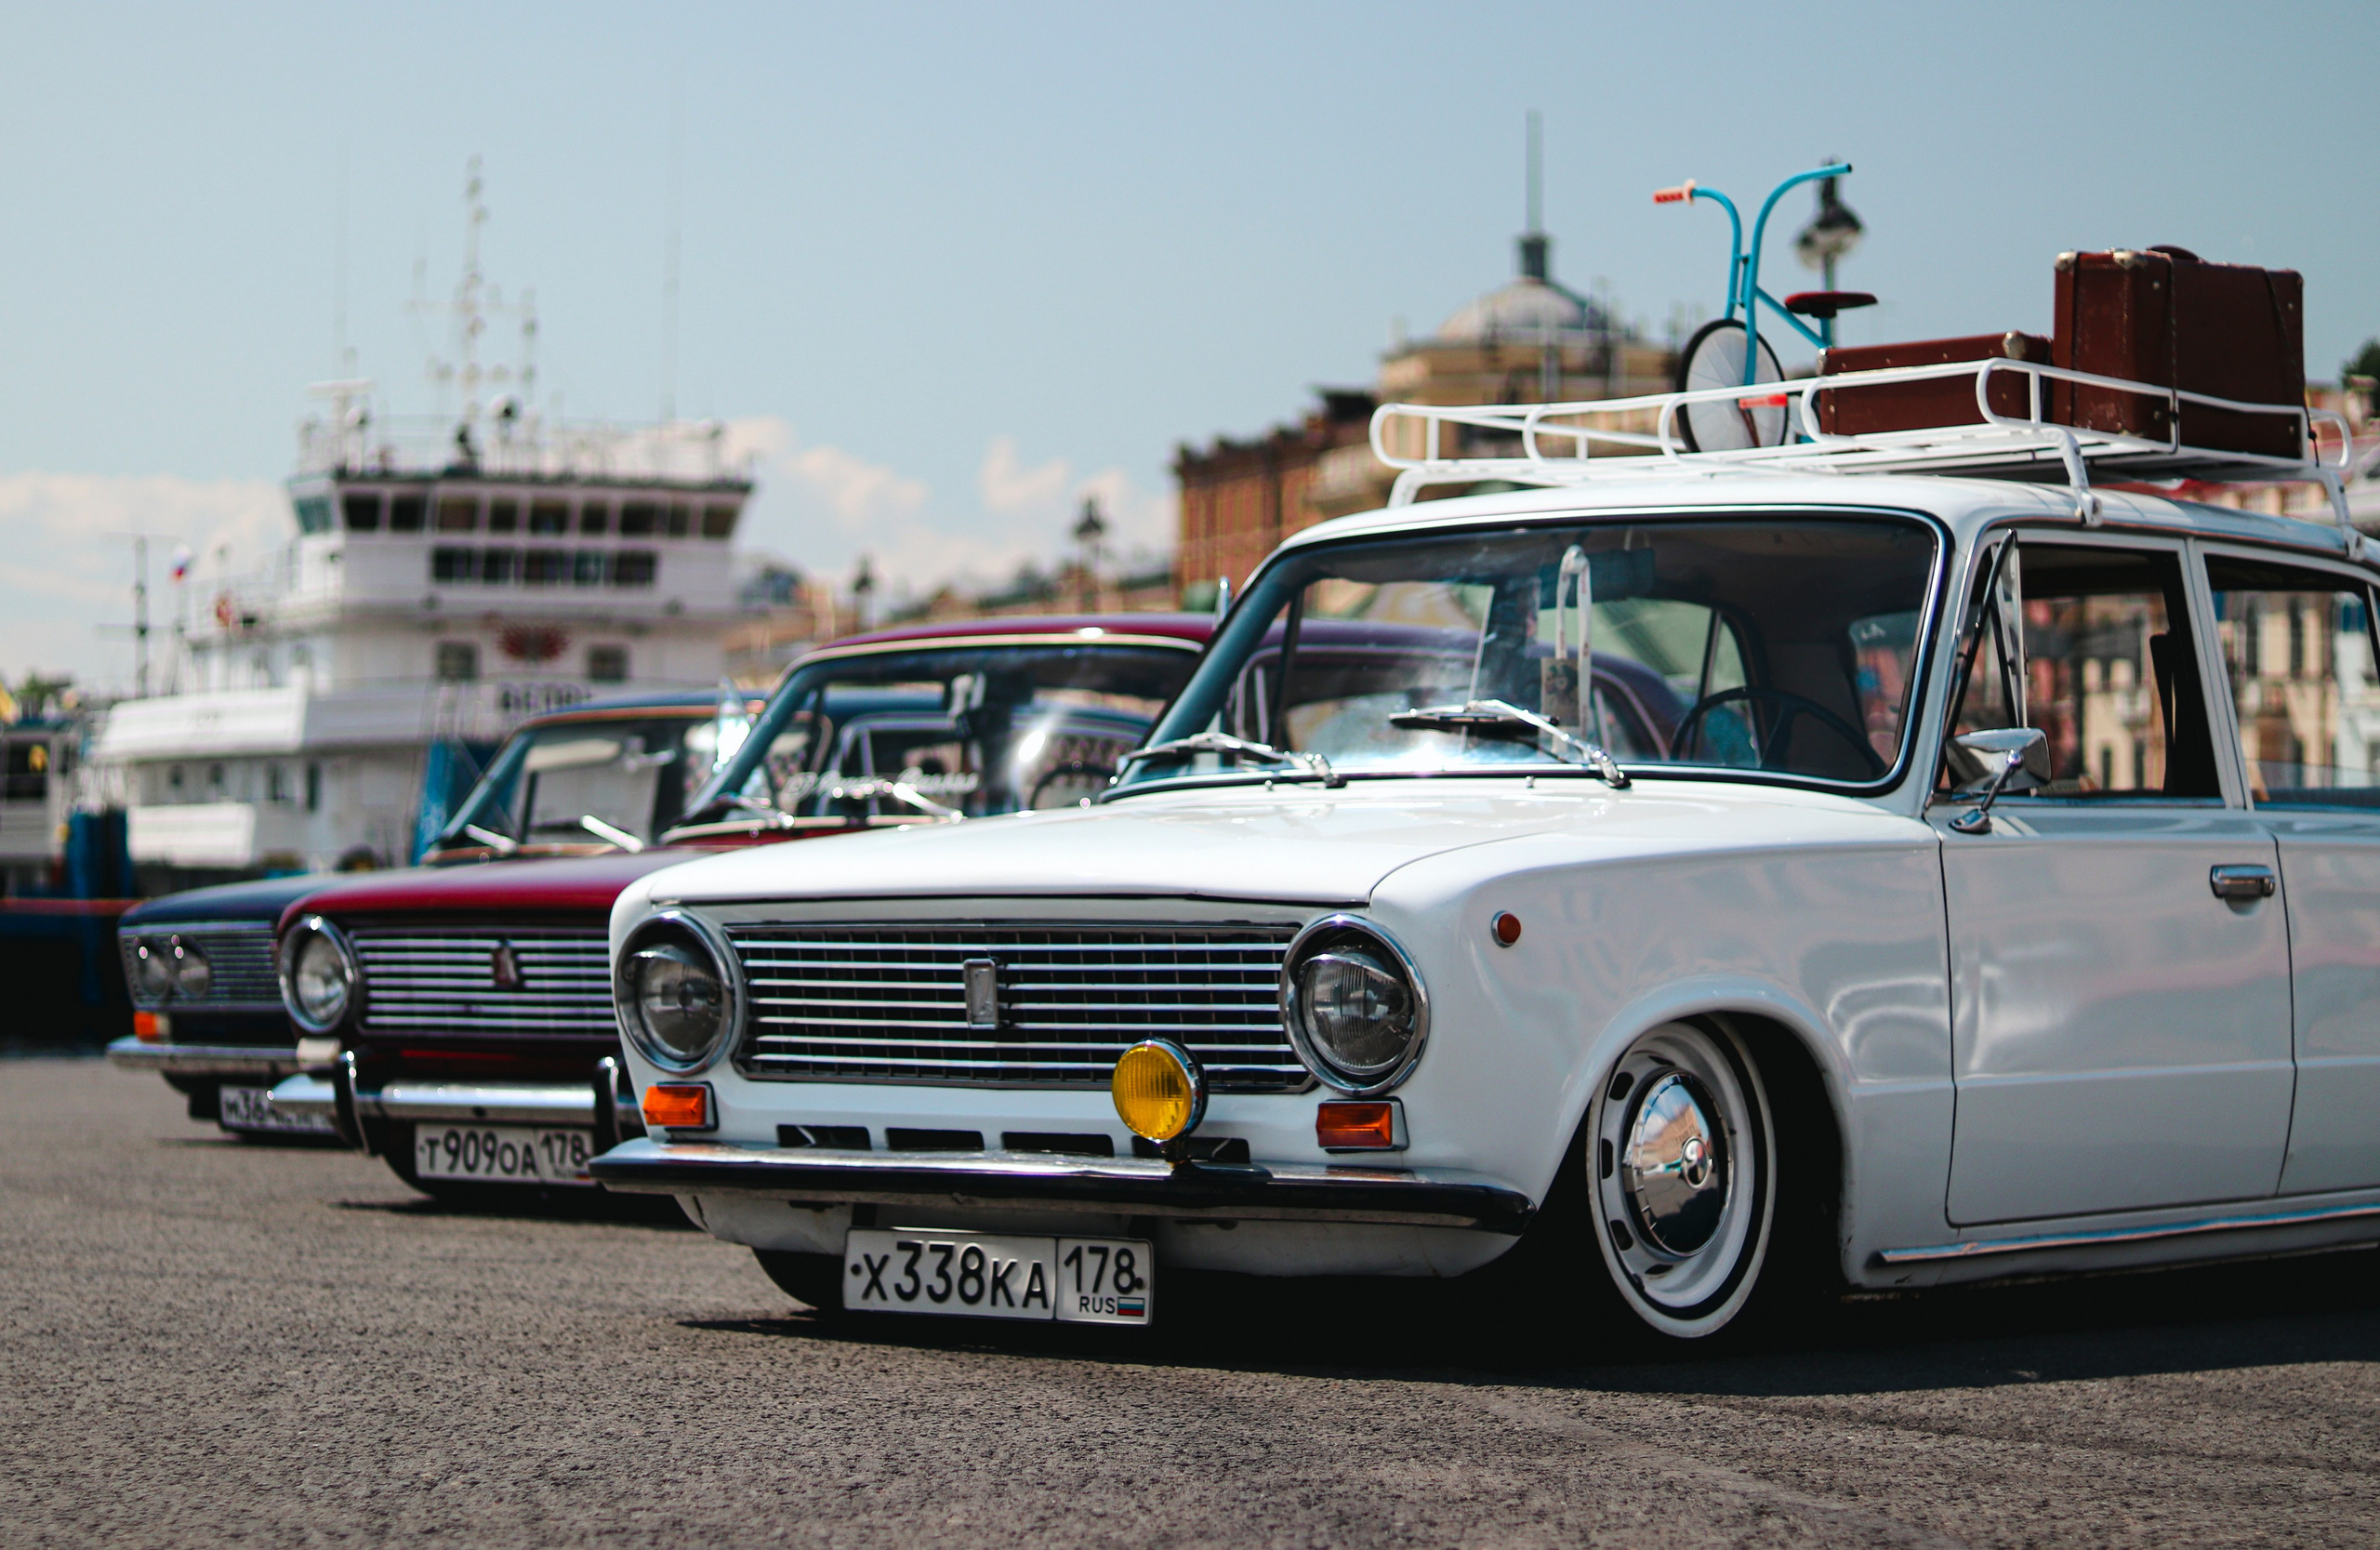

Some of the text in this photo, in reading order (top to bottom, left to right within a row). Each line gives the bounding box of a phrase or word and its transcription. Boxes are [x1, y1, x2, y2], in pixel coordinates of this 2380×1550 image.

[541, 1133, 588, 1168] 178
[1064, 1245, 1135, 1294] 178
[1079, 1296, 1116, 1314] RUS
